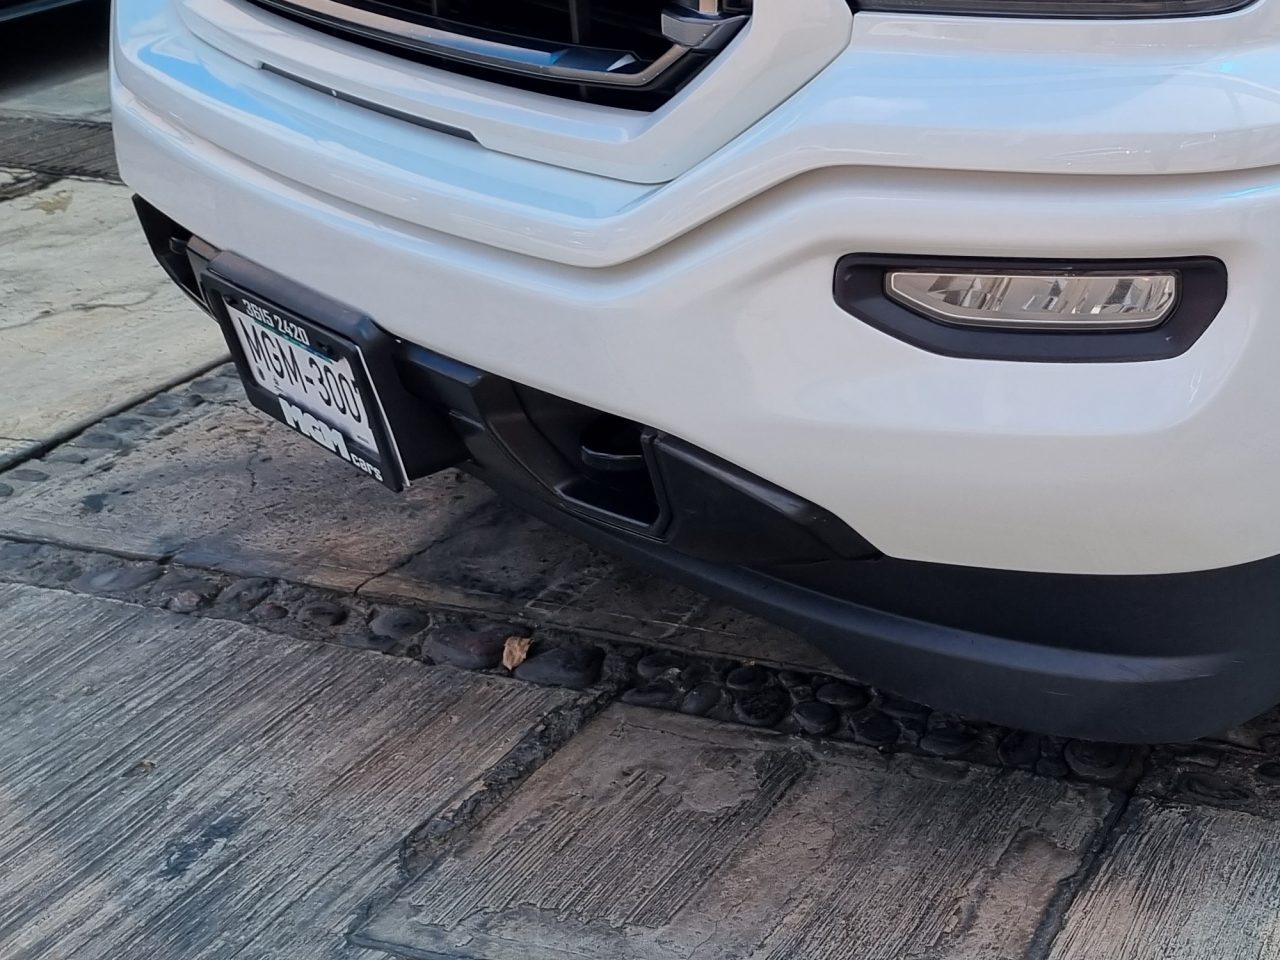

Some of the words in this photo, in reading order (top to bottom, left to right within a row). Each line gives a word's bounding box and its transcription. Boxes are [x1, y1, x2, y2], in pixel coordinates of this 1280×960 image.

[242, 298, 275, 330] 3615
[272, 314, 310, 346] 2420
[278, 397, 352, 462] MGM
[350, 452, 384, 482] cars
